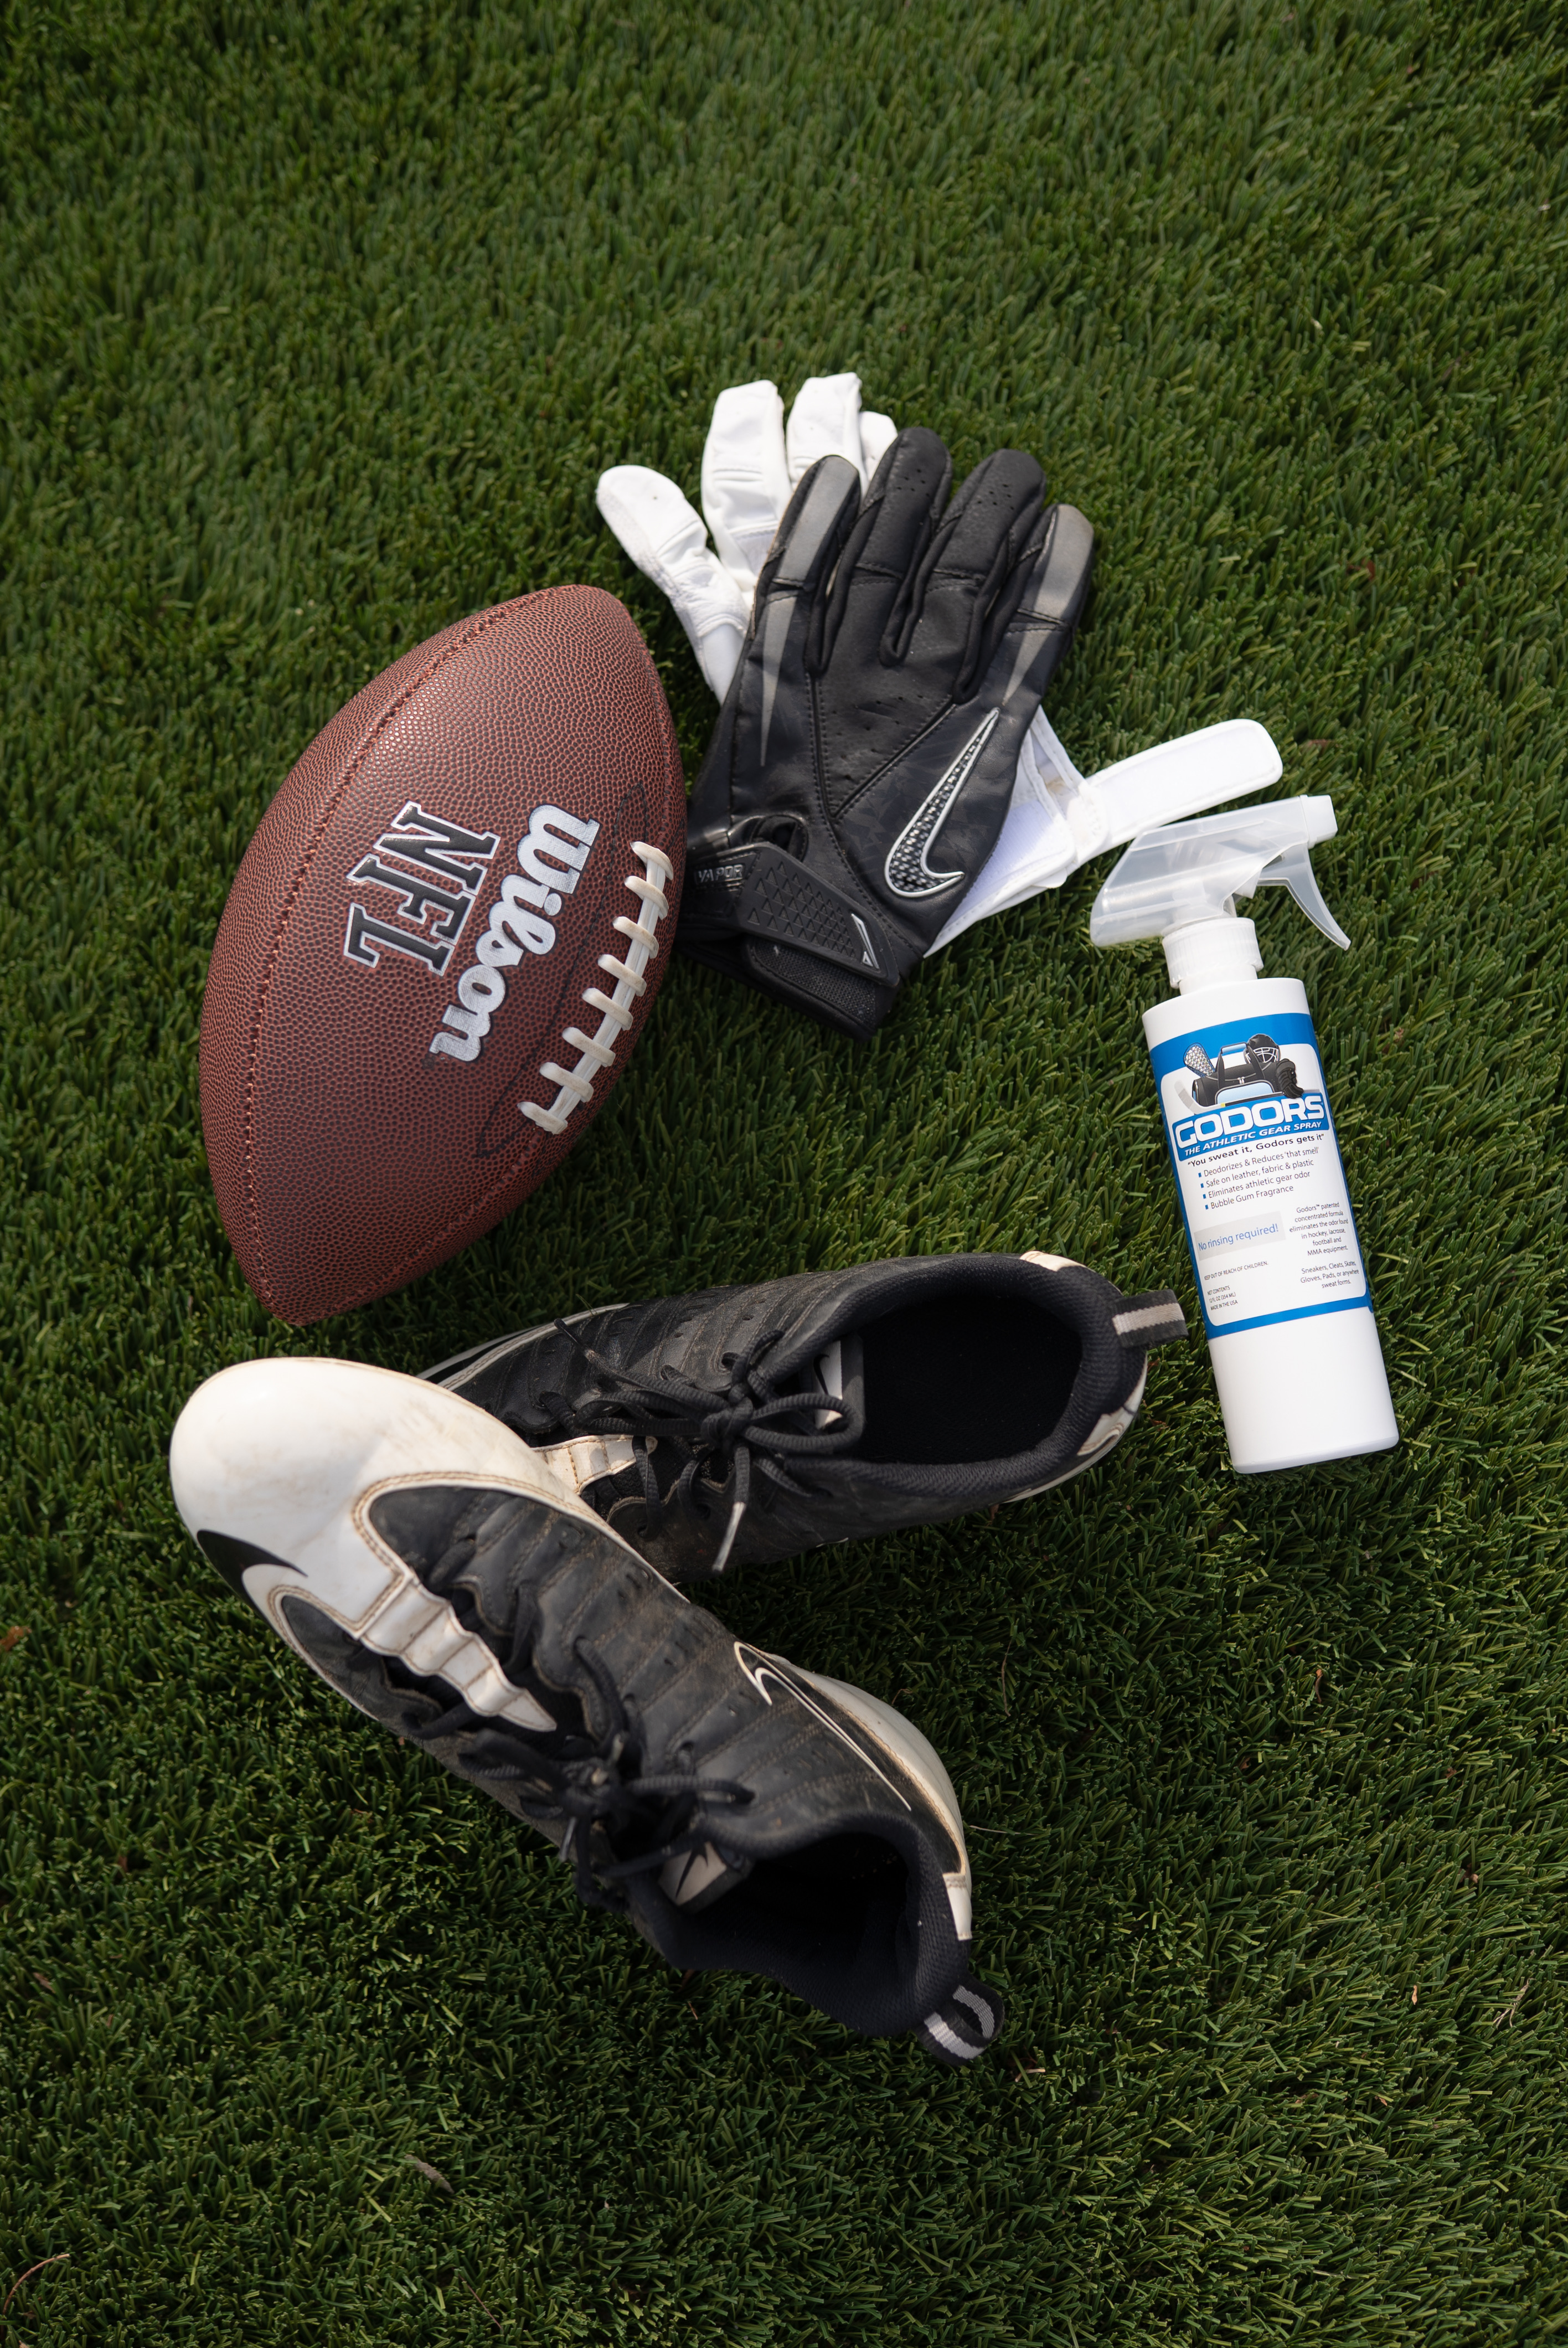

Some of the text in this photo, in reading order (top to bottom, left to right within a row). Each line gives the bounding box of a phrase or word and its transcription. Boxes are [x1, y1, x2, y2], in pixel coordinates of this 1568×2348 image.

[698, 864, 742, 883] VAPOR
[343, 800, 501, 976] NFL
[429, 805, 600, 1062] Wilson
[1175, 1096, 1324, 1149] GODORS
[1185, 1121, 1322, 1156] THE ATHLETIC GEAR SPRAY
[1208, 1149, 1239, 1162] sweat
[1256, 1139, 1293, 1150] Godors
[1297, 1134, 1314, 1144] gets
[1204, 1162, 1243, 1177] Deodorizes
[1252, 1153, 1284, 1164] Reduces
[1206, 1179, 1220, 1188] Safe
[1232, 1168, 1261, 1181] leather,
[1262, 1163, 1284, 1174] fabric
[1292, 1159, 1314, 1170] plastic
[1208, 1170, 1310, 1199] Eliminates athletic gear odor
[1210, 1185, 1294, 1209] Bubble Gum Fragrance
[1321, 1202, 1340, 1211] patented
[1294, 1212, 1328, 1222] concentrated
[1198, 1223, 1278, 1251] No rinsing required!
[1289, 1223, 1318, 1233] eliminates
[1308, 1230, 1328, 1238] hockey,
[1313, 1237, 1333, 1247] football
[1244, 1260, 1269, 1270] CHILDREN.
[1301, 1264, 1329, 1274] Sneakers,
[1300, 1275, 1322, 1284] Gloves,
[1321, 1280, 1337, 1289] sweat
[1213, 1285, 1231, 1294] CONTENTS
